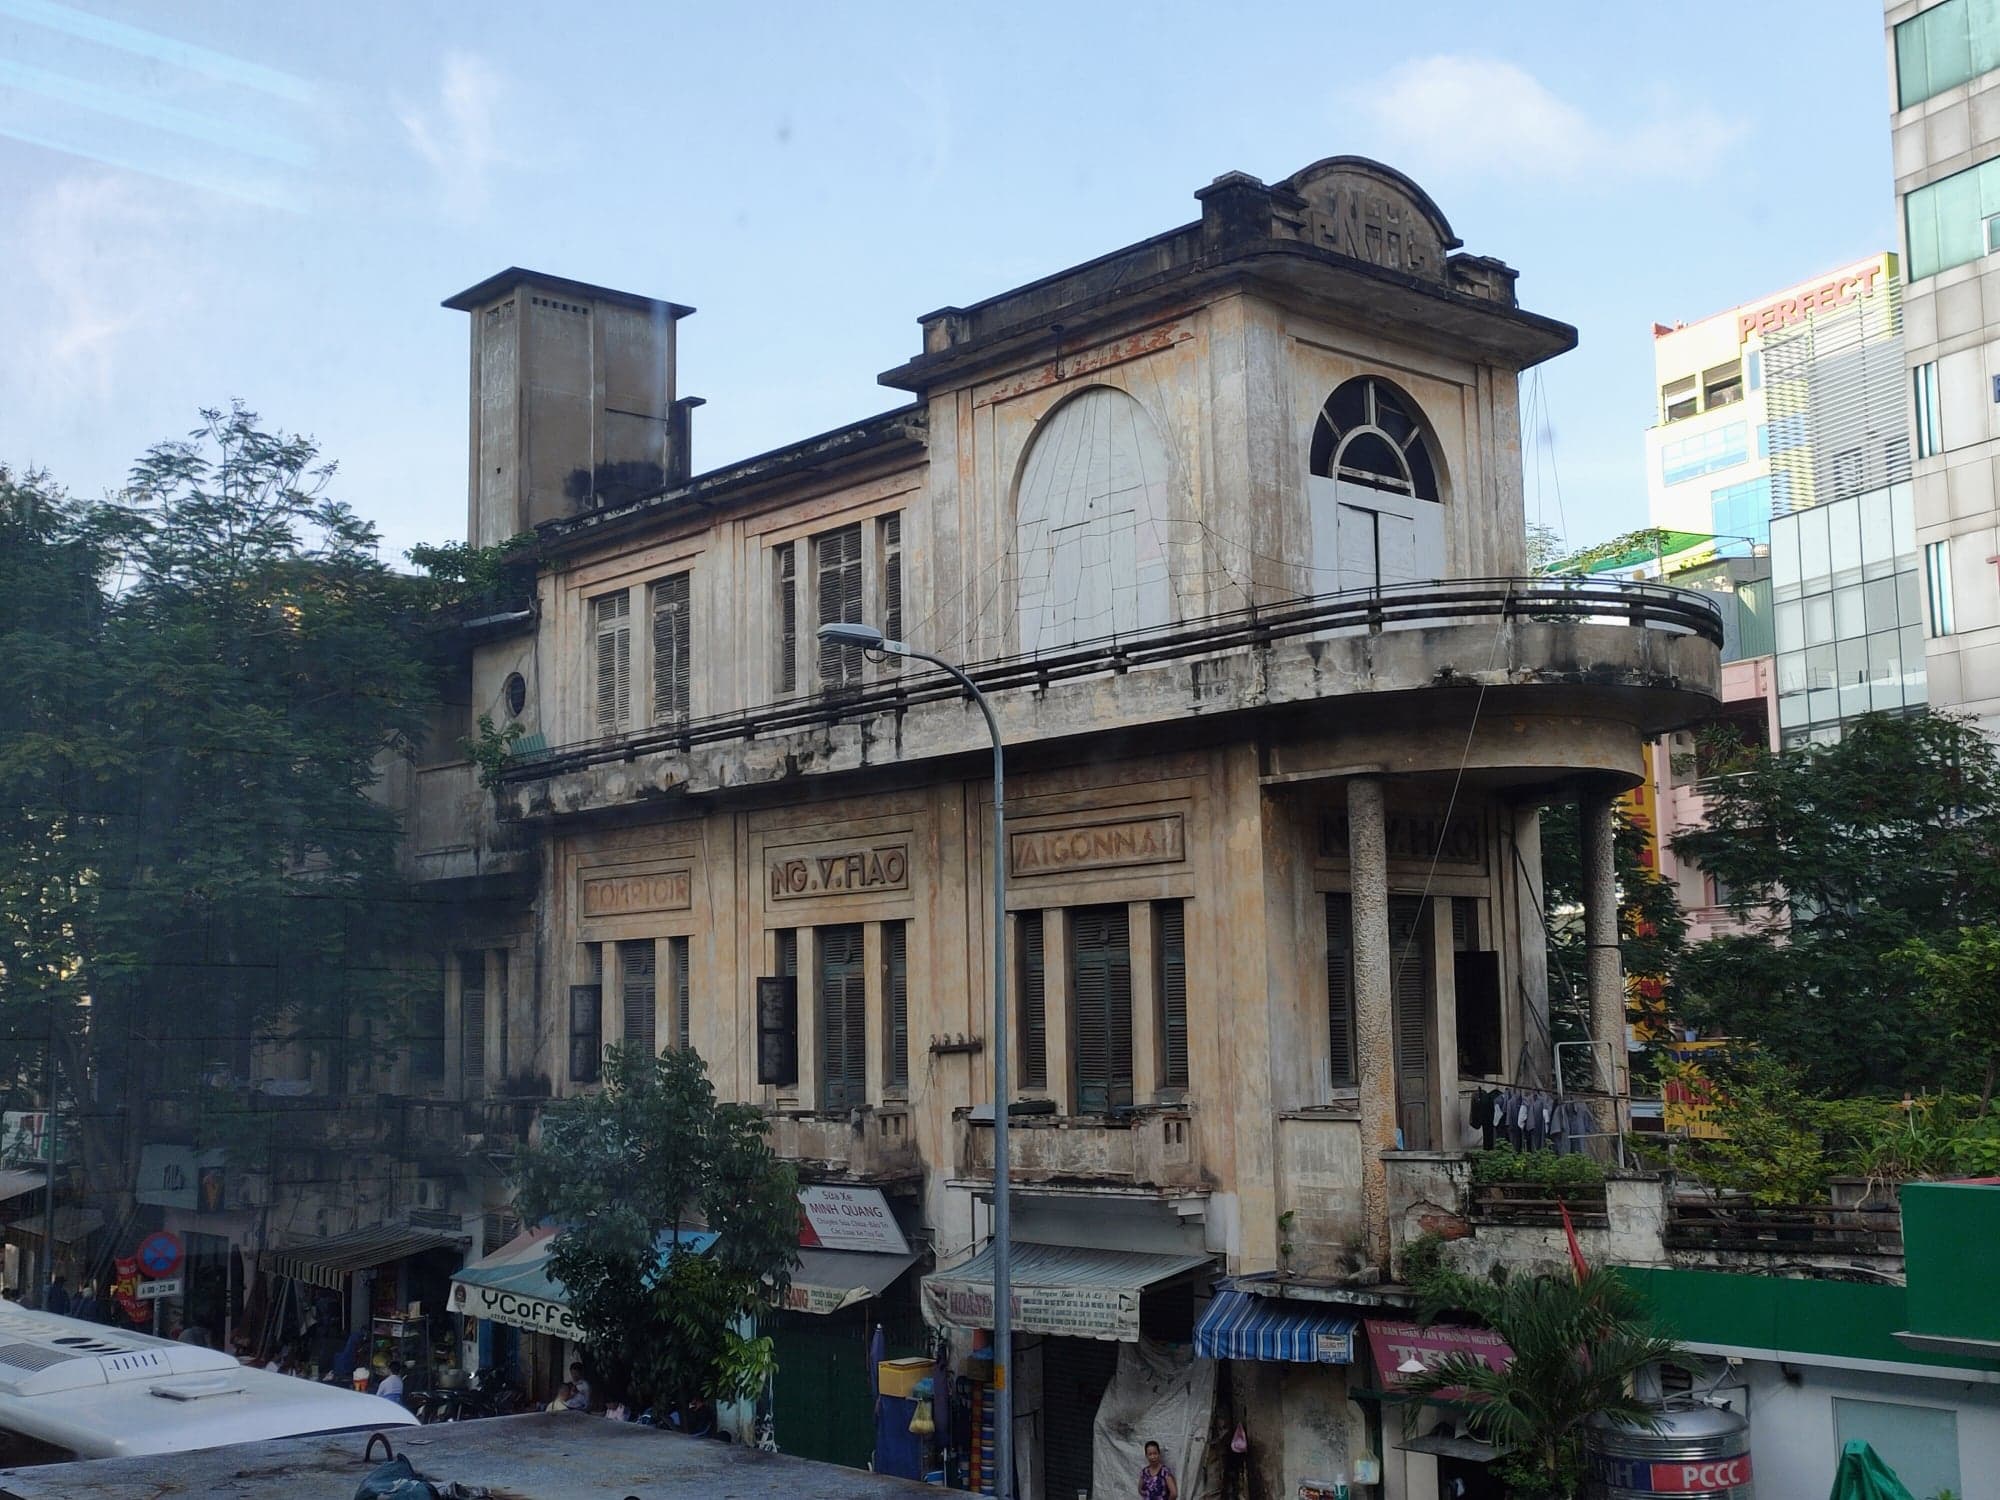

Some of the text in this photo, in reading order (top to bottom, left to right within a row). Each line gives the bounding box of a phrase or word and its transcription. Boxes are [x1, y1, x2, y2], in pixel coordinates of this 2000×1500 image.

[1737, 265, 1881, 344] PERFECT
[809, 1203, 884, 1217] MINH QUANG
[1681, 1461, 1741, 1489] PCCC
